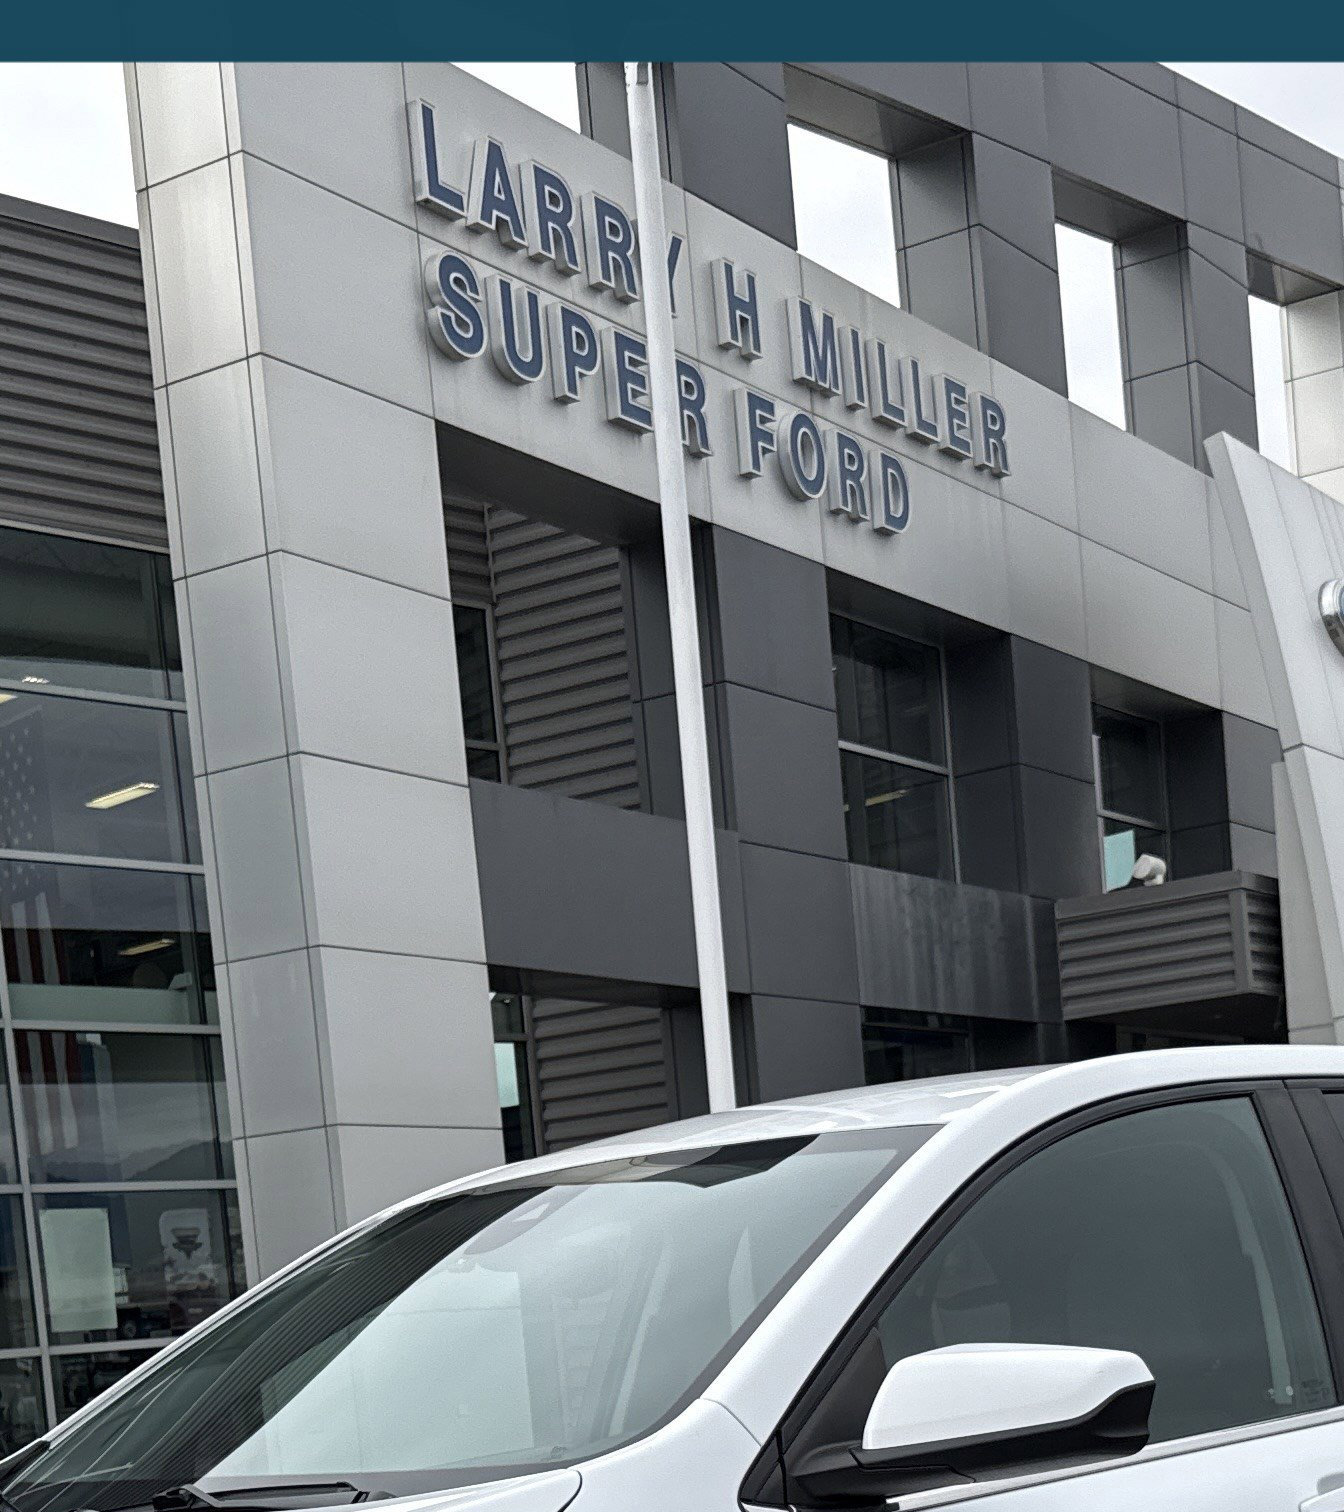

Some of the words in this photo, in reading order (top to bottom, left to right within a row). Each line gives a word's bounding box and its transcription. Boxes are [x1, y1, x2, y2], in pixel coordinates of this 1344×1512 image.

[425, 250, 712, 458] SUPER
[734, 386, 910, 535] FORD
[712, 258, 762, 360] H
[787, 297, 1011, 478] MILLER
